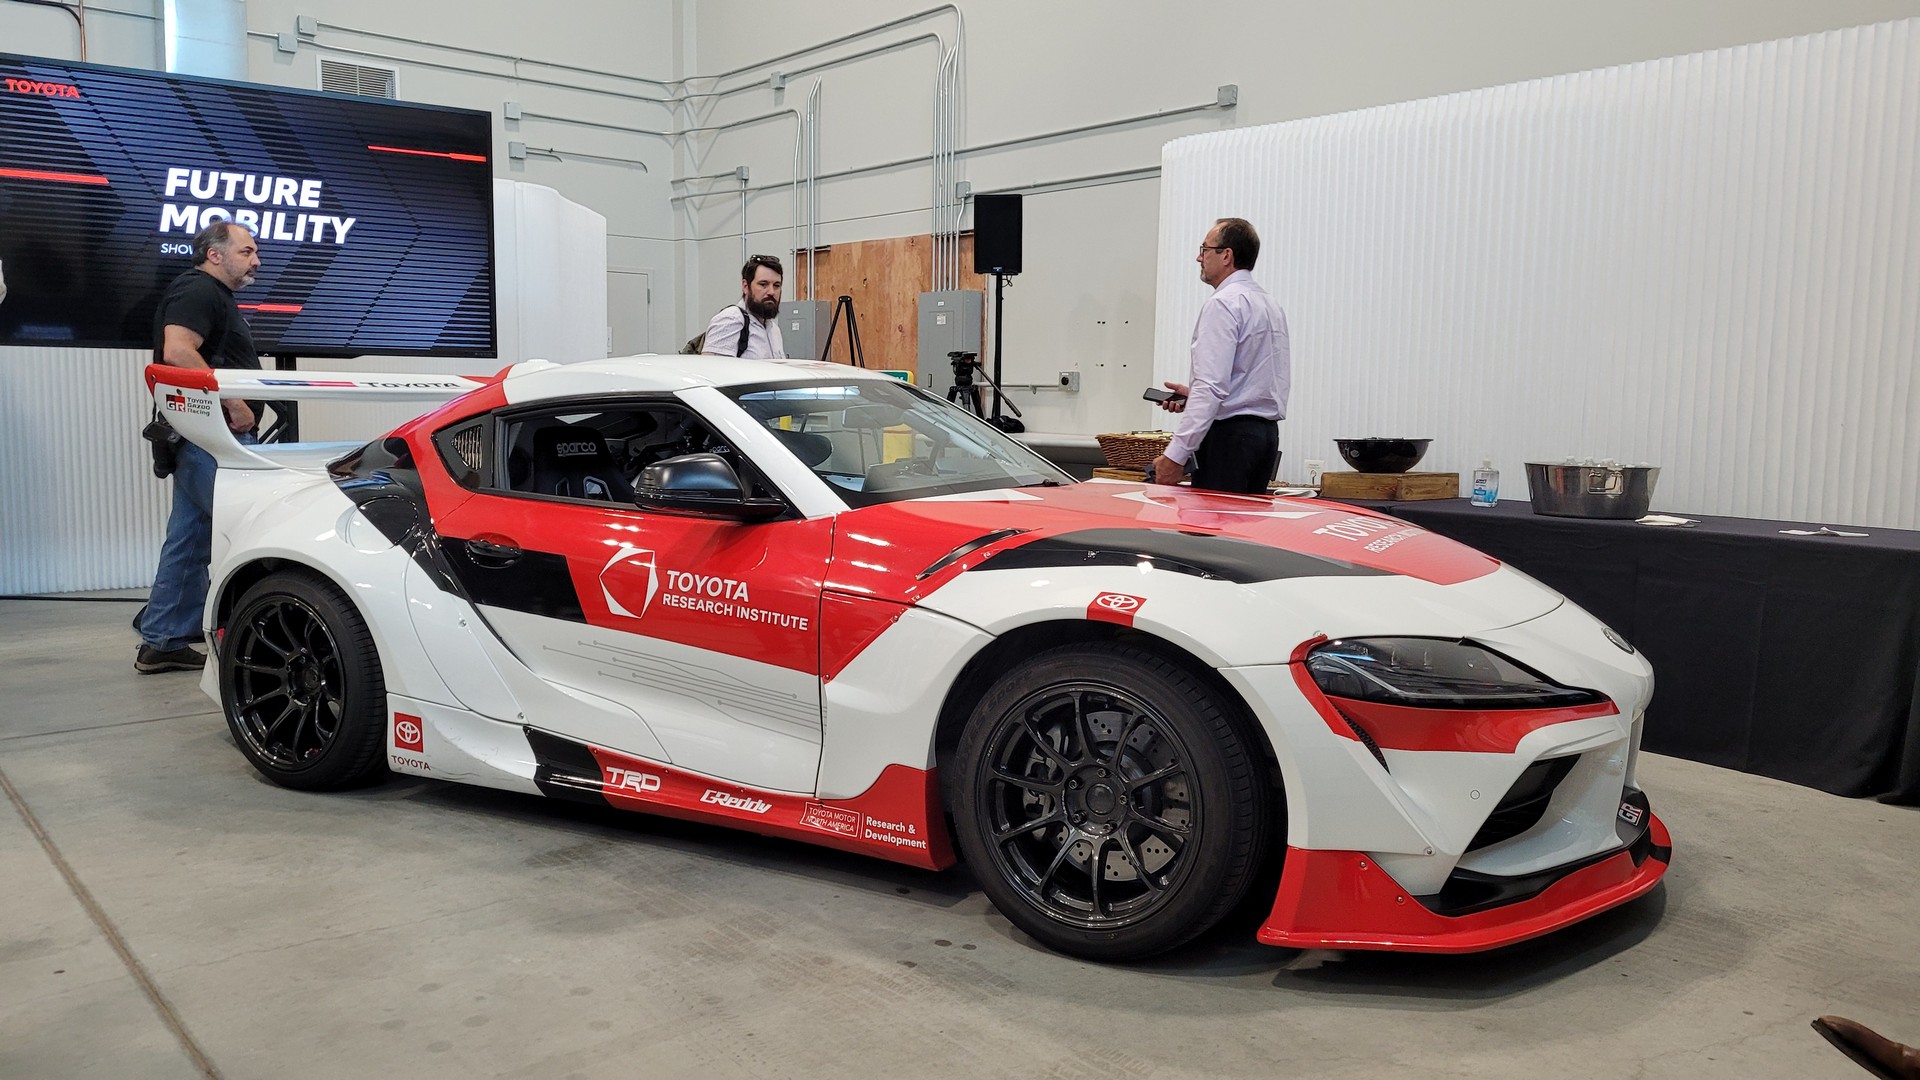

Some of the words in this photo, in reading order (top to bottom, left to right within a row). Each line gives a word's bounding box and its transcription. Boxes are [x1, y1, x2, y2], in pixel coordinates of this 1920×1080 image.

[5, 79, 80, 98] TOYOTA
[165, 168, 322, 208] FUTURE
[159, 203, 356, 244] MOBILITY
[161, 243, 193, 255] SHO
[166, 400, 186, 413] GR
[187, 397, 213, 405] TOYOTA
[187, 402, 211, 411] GAZOO
[556, 441, 597, 455] sparco
[666, 570, 749, 602] TOYOTA
[662, 593, 733, 617] RESEARCH
[736, 606, 809, 631] INSTITUTE
[391, 755, 431, 770] TOYOTA
[606, 766, 661, 793] TRD
[700, 789, 772, 814] GReddy
[809, 807, 833, 819] TOYOTA
[834, 812, 856, 823] MOTOR
[1618, 802, 1642, 824] GR
[806, 815, 828, 827] NORTH
[828, 821, 854, 832] AMERICA
[866, 816, 906, 832] Research
[908, 825, 916, 834] &
[865, 829, 927, 849] Development
